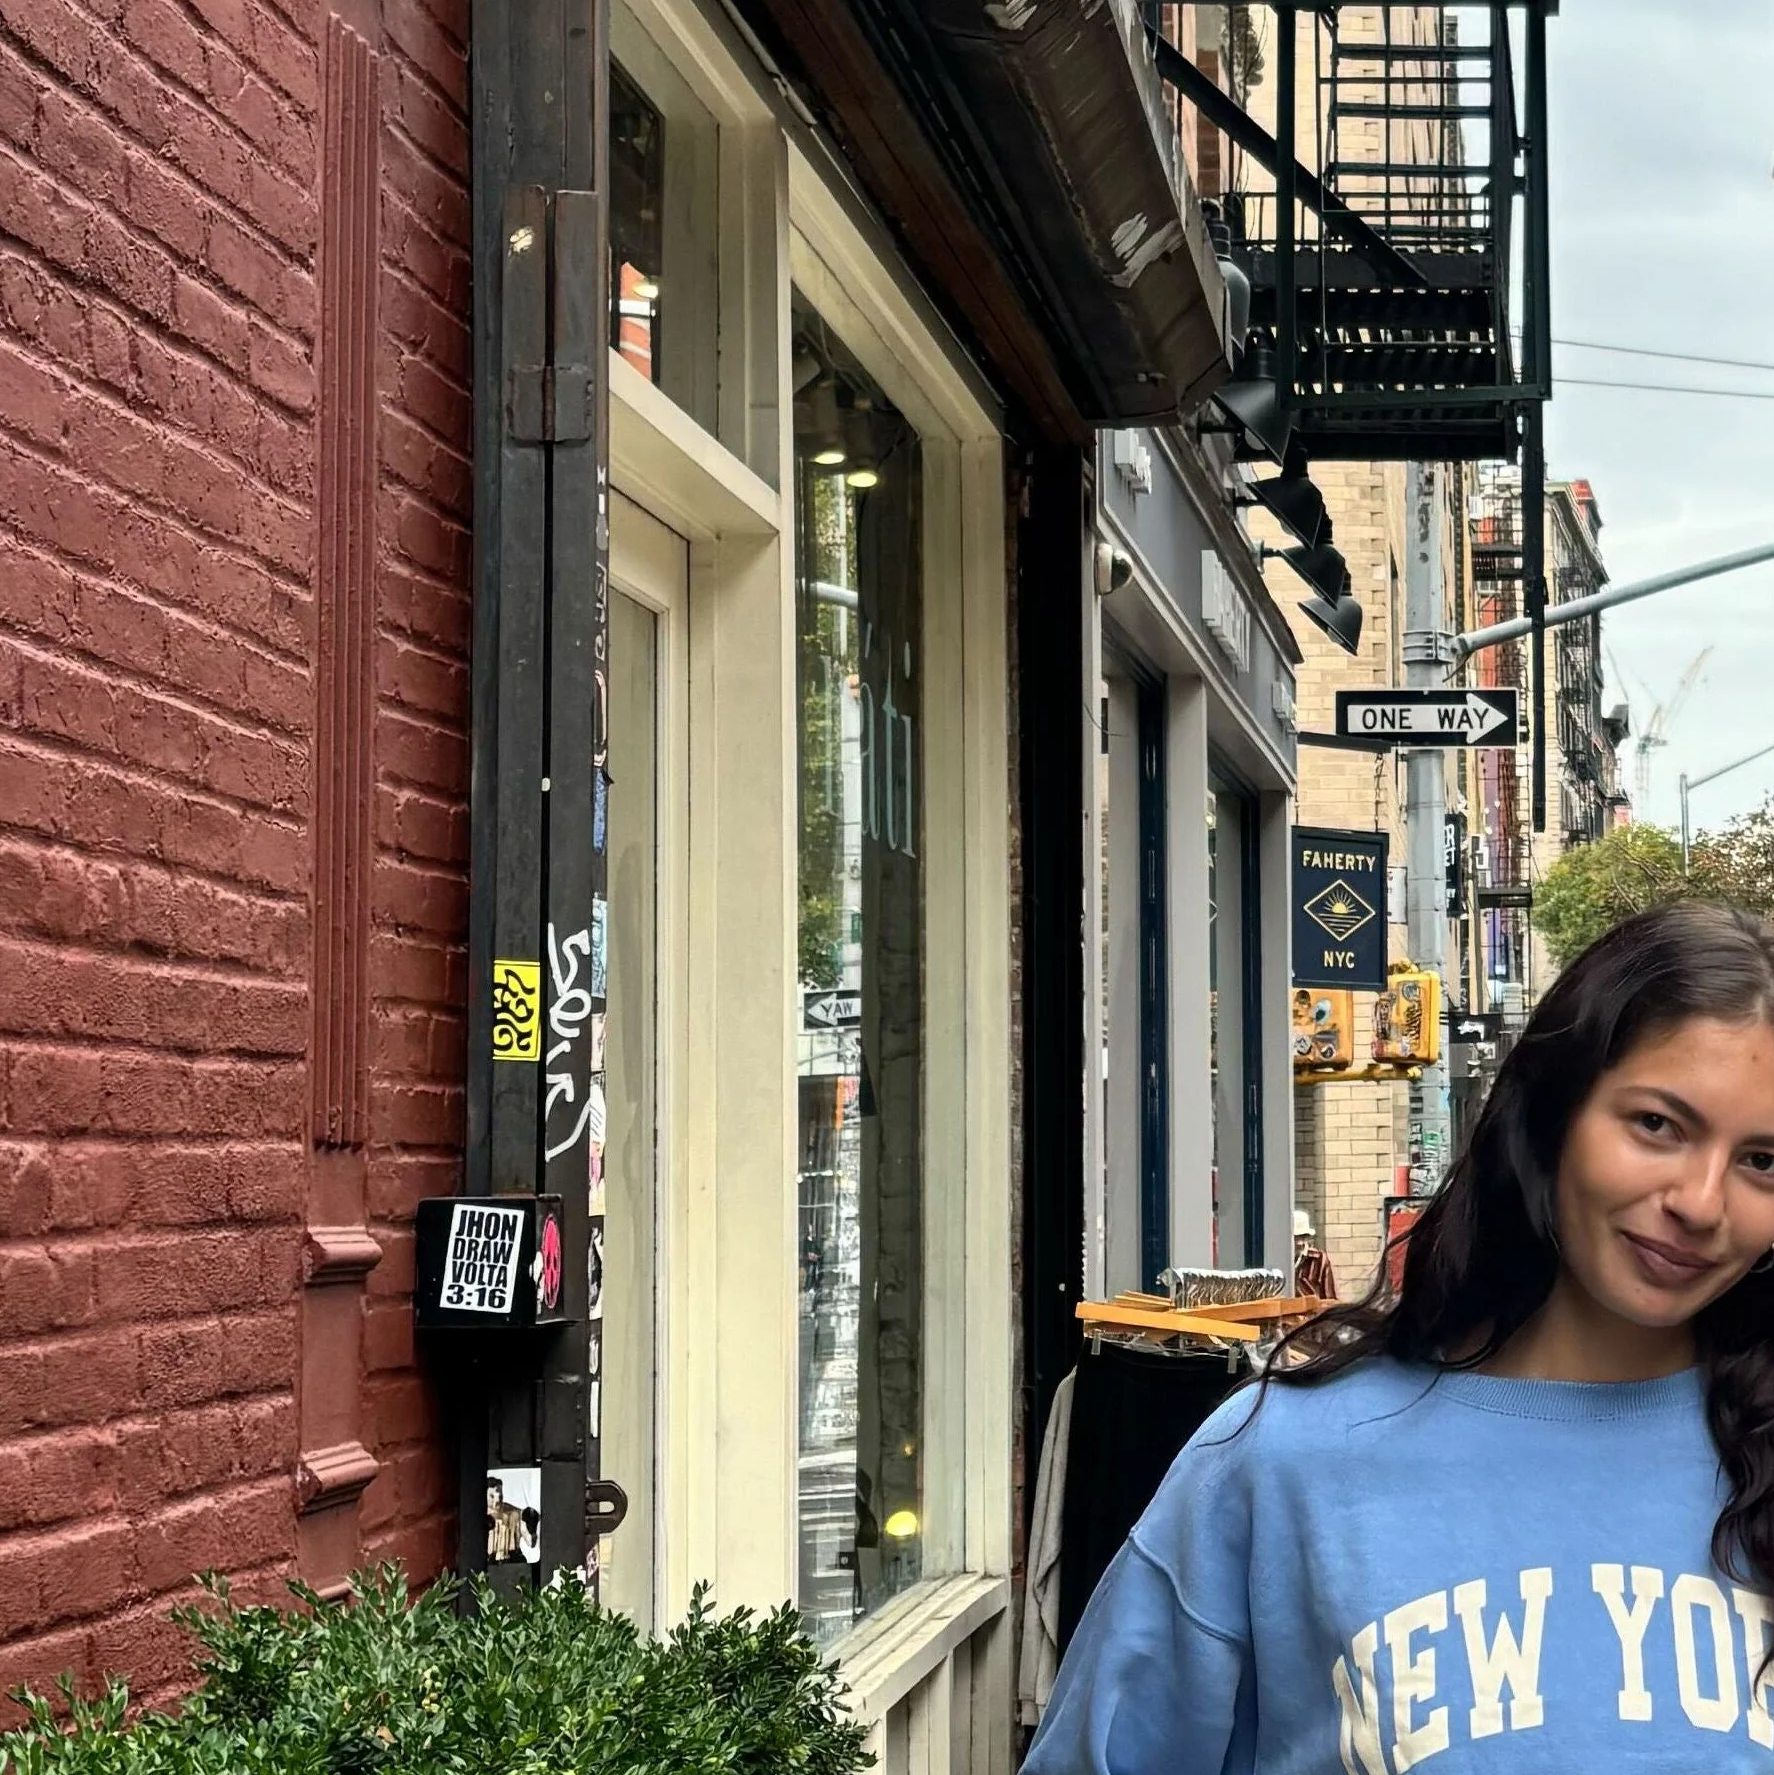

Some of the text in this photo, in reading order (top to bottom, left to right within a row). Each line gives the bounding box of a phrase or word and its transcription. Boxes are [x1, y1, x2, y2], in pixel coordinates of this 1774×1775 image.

[1362, 707, 1490, 730] ONE WAY
[1302, 851, 1376, 873] FAHERTY
[1324, 950, 1355, 969] NYC
[455, 1209, 518, 1242] JHON
[452, 1238, 514, 1265] DRAW
[451, 1261, 508, 1288] VOLTA
[446, 1284, 507, 1308] 3:16
